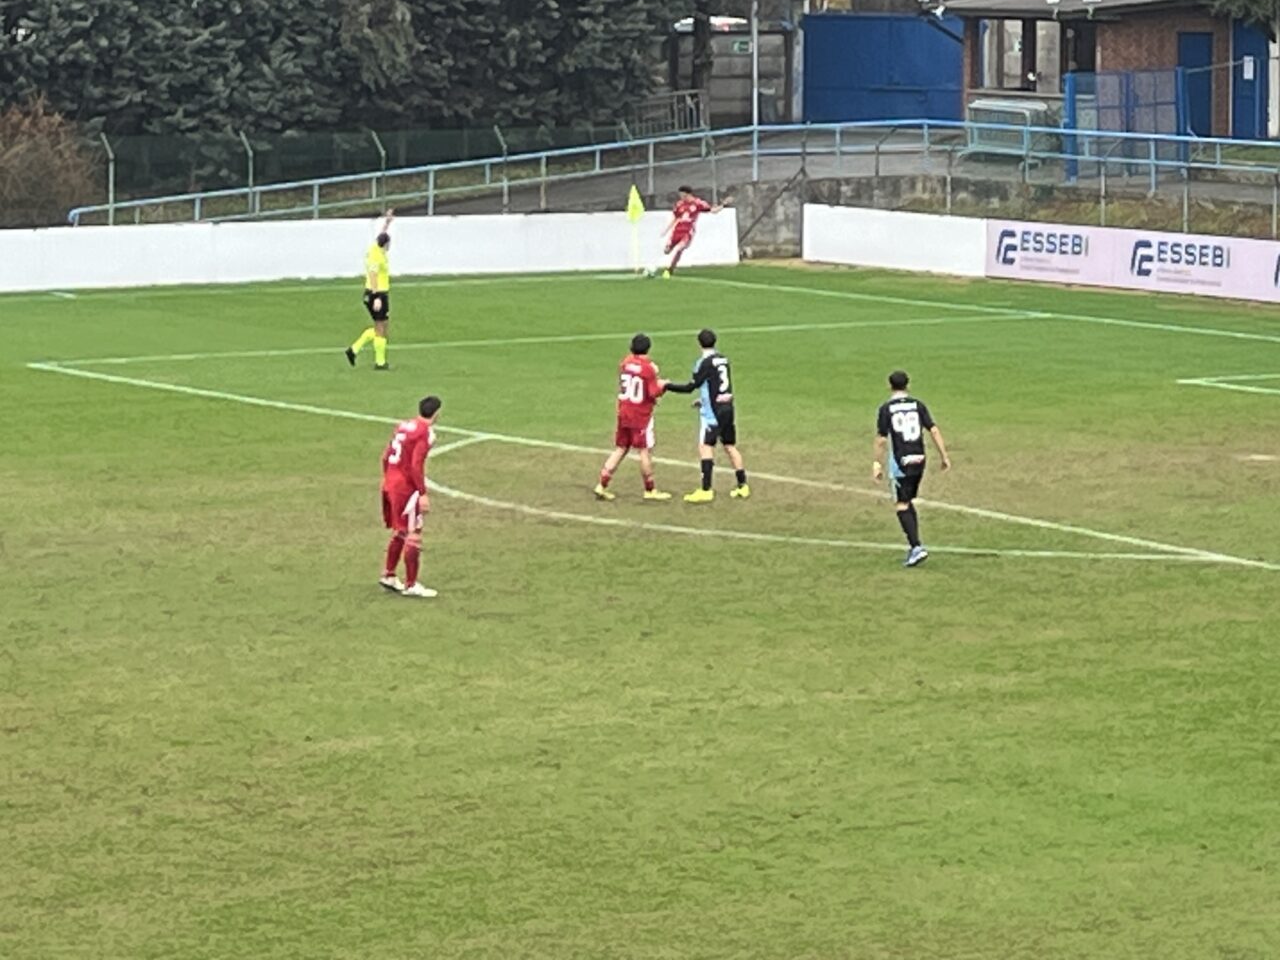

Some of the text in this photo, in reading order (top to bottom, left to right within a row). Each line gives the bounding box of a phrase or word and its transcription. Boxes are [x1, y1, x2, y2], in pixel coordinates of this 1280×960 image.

[1020, 230, 1089, 257] ESSEBI
[1157, 241, 1231, 269] ESSEBI
[618, 373, 644, 404] 30
[717, 364, 729, 393] 3
[891, 411, 920, 442] 98
[388, 432, 406, 464] 5
